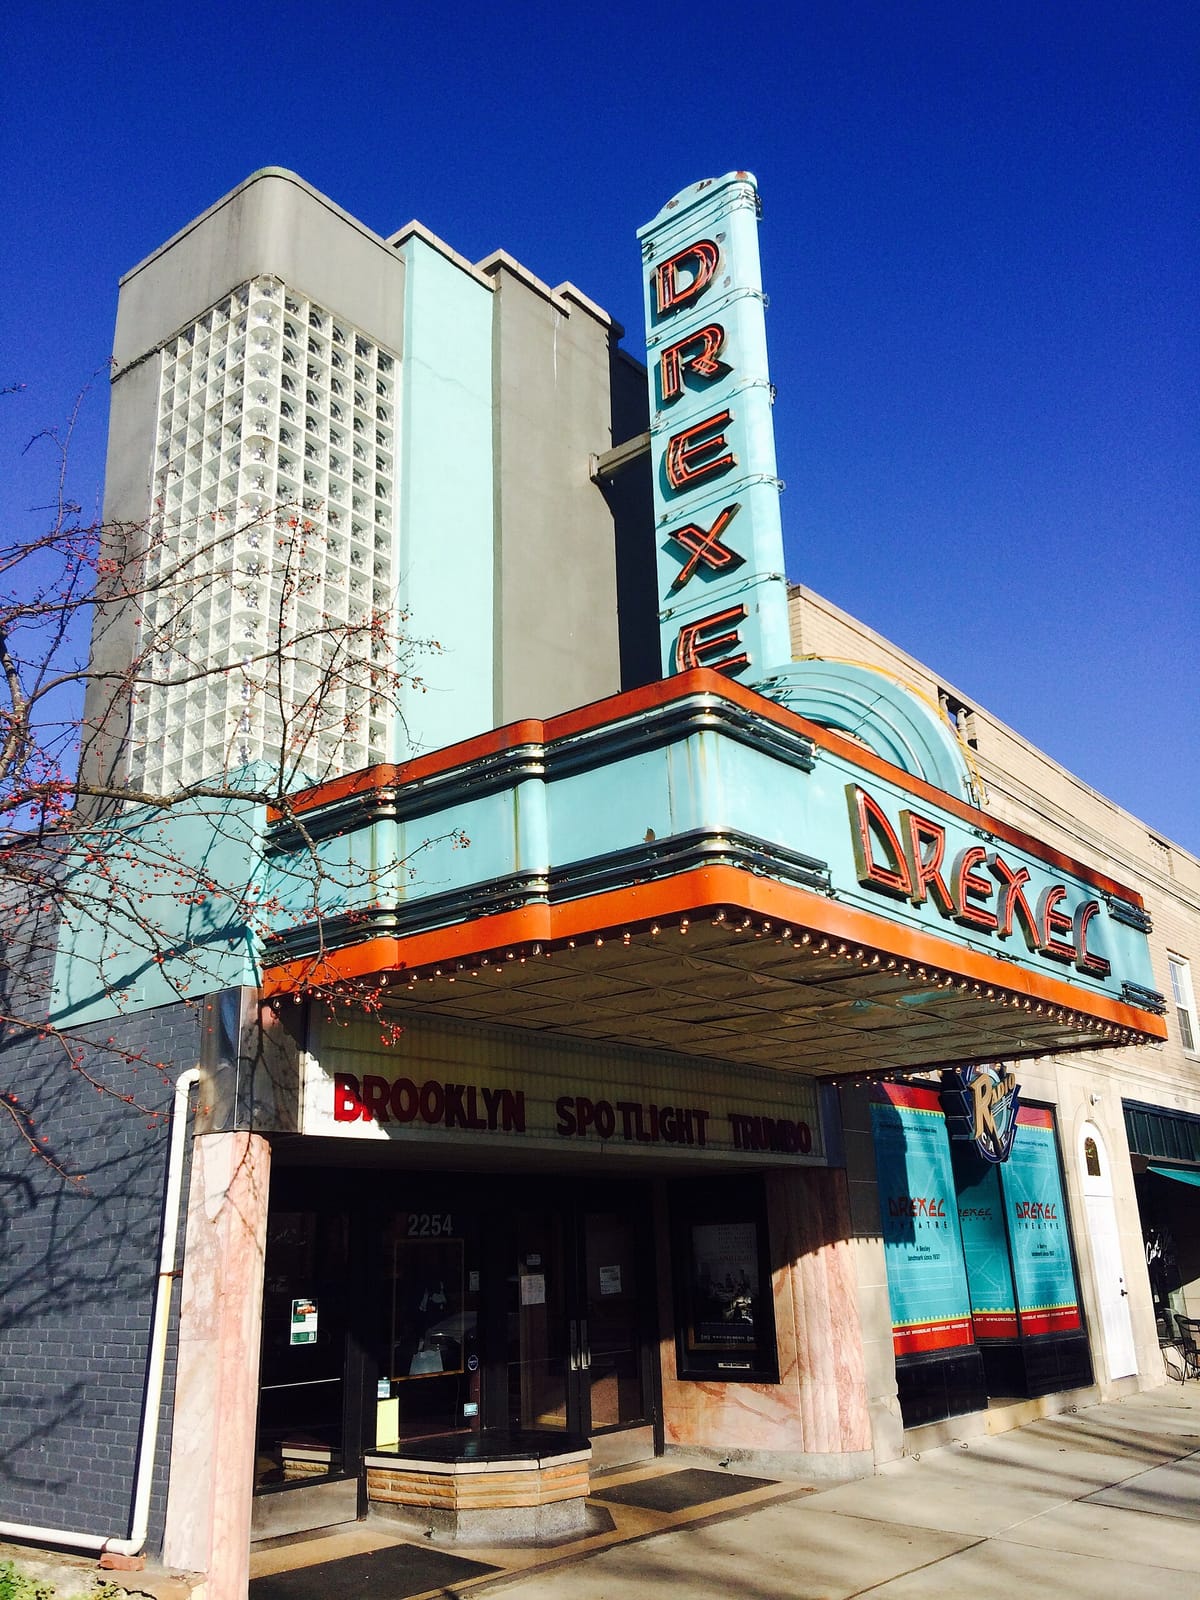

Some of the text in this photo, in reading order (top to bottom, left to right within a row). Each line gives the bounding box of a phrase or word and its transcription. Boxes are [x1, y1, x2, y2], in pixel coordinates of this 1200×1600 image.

[845, 783, 1110, 980] DREXEL
[333, 1072, 812, 1154] BROOKLYN SPOTLIGHT TRUMBO
[970, 1072, 1016, 1150] RADIO
[980, 1131, 1008, 1153] CAE
[888, 1196, 946, 1217] DREXEL
[1015, 1201, 1057, 1219] DREXEL
[408, 1214, 454, 1236] 2254
